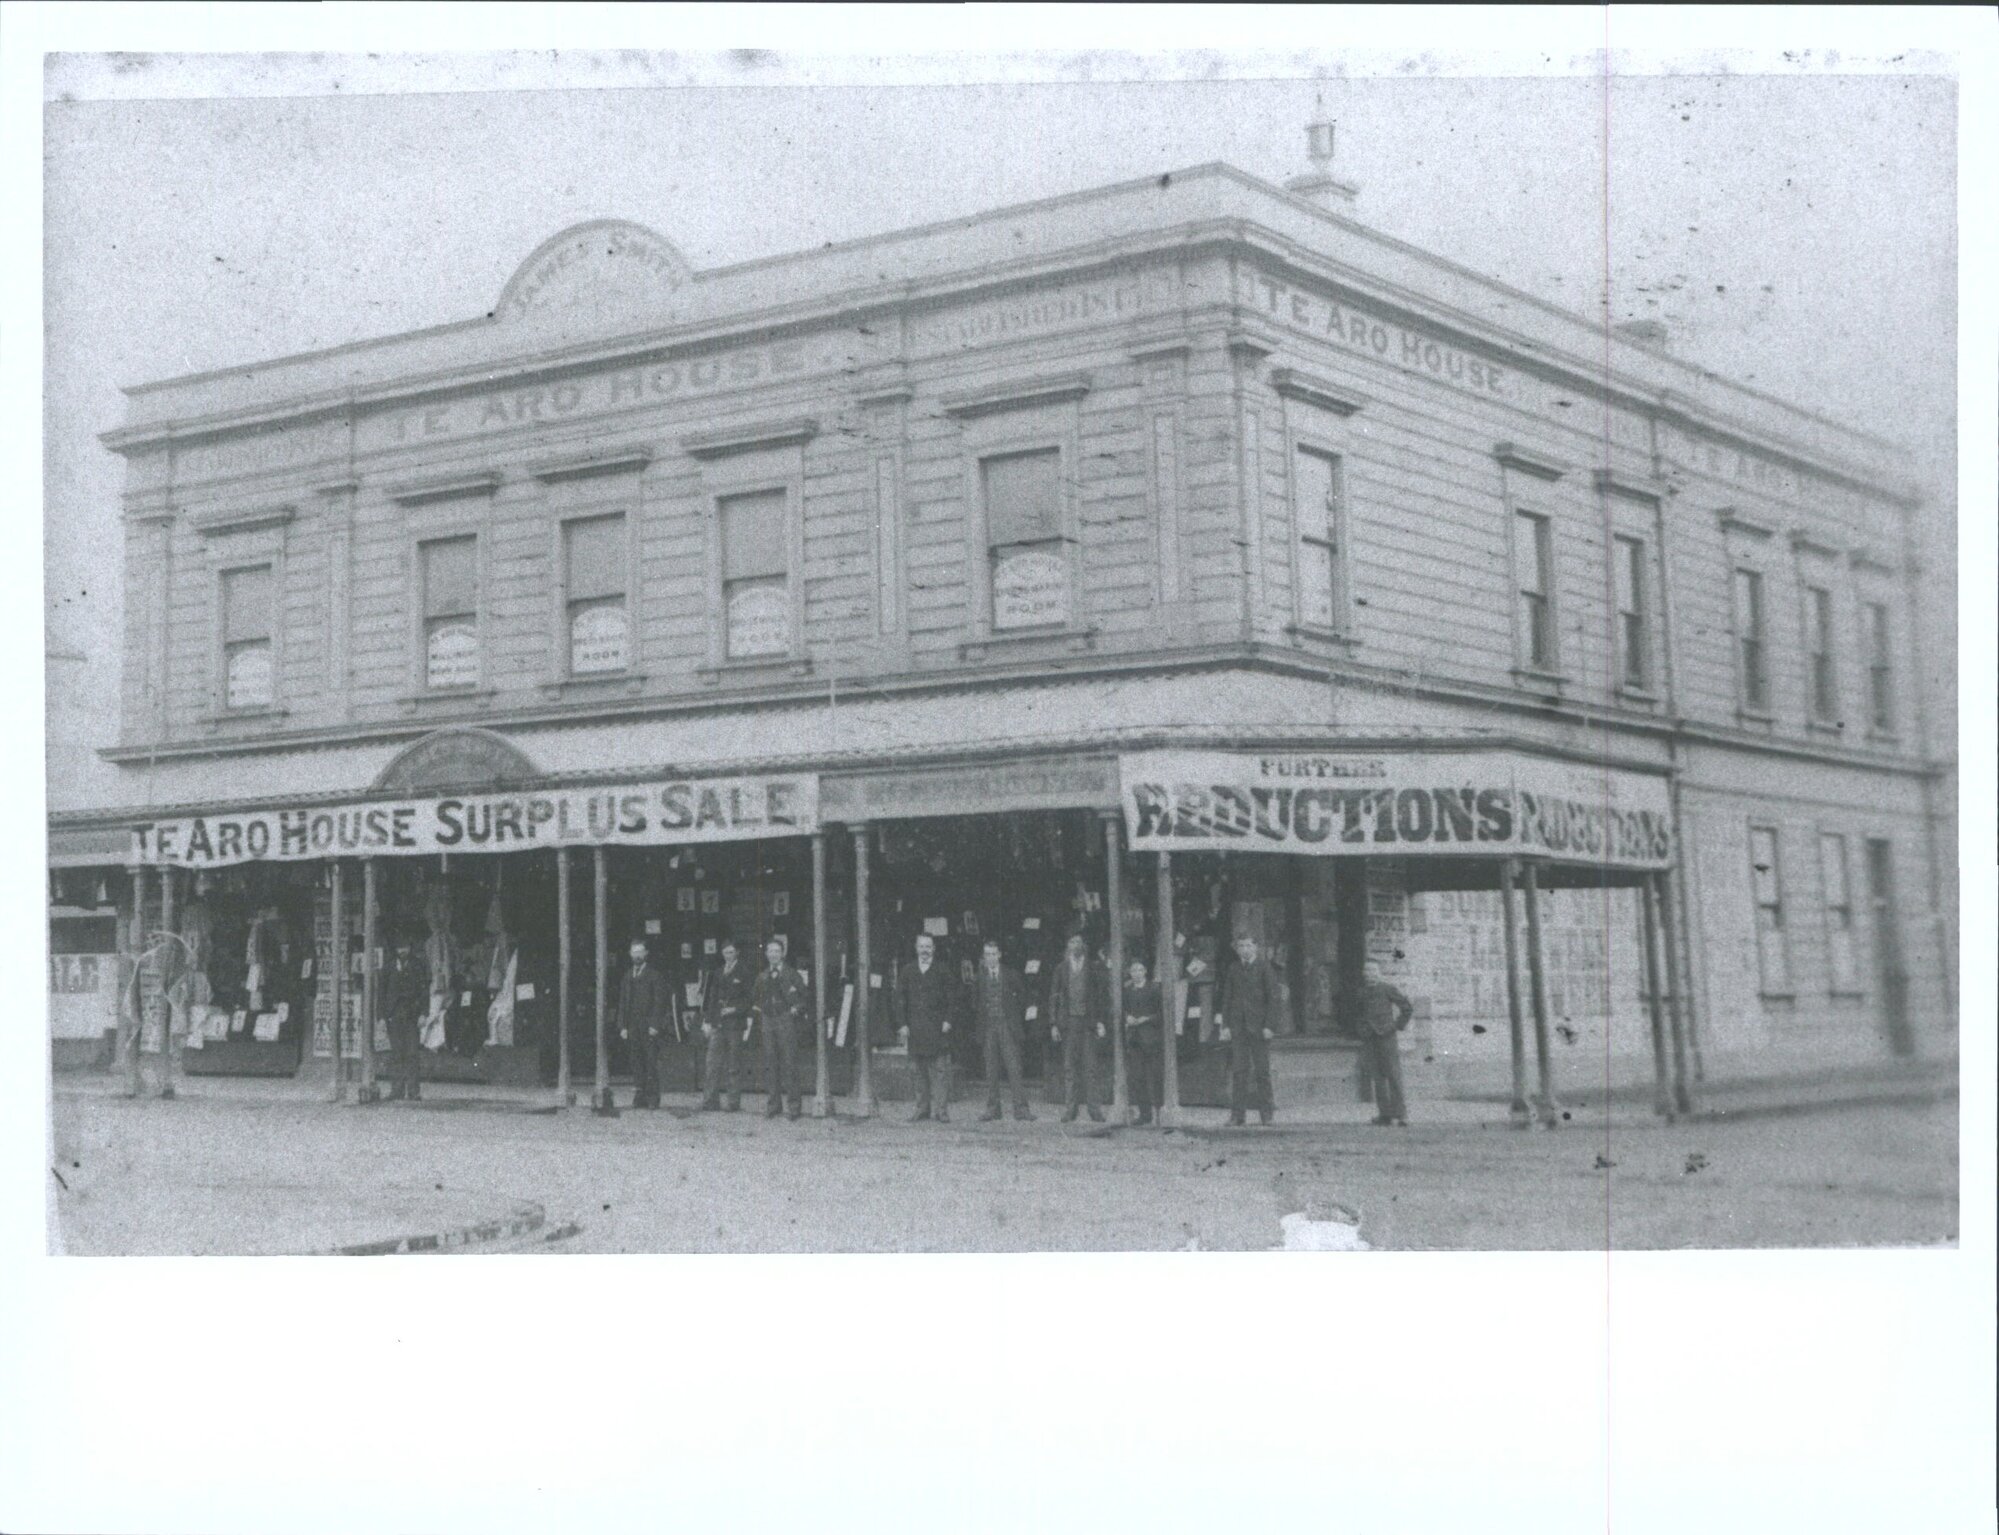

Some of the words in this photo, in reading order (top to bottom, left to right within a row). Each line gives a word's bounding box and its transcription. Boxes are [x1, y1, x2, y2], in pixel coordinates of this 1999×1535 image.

[1258, 275, 1309, 325] TE
[1327, 304, 1389, 354] ARO
[1401, 332, 1503, 393] HOUSE
[389, 405, 451, 442] TE
[481, 384, 582, 427] ARO
[609, 343, 804, 403] HOUSE
[132, 823, 178, 861] TE
[186, 818, 270, 862] ARO
[280, 808, 416, 856] HOUSE
[435, 796, 648, 846] SURPLUS
[1132, 781, 1513, 843] REDUCTIONS
